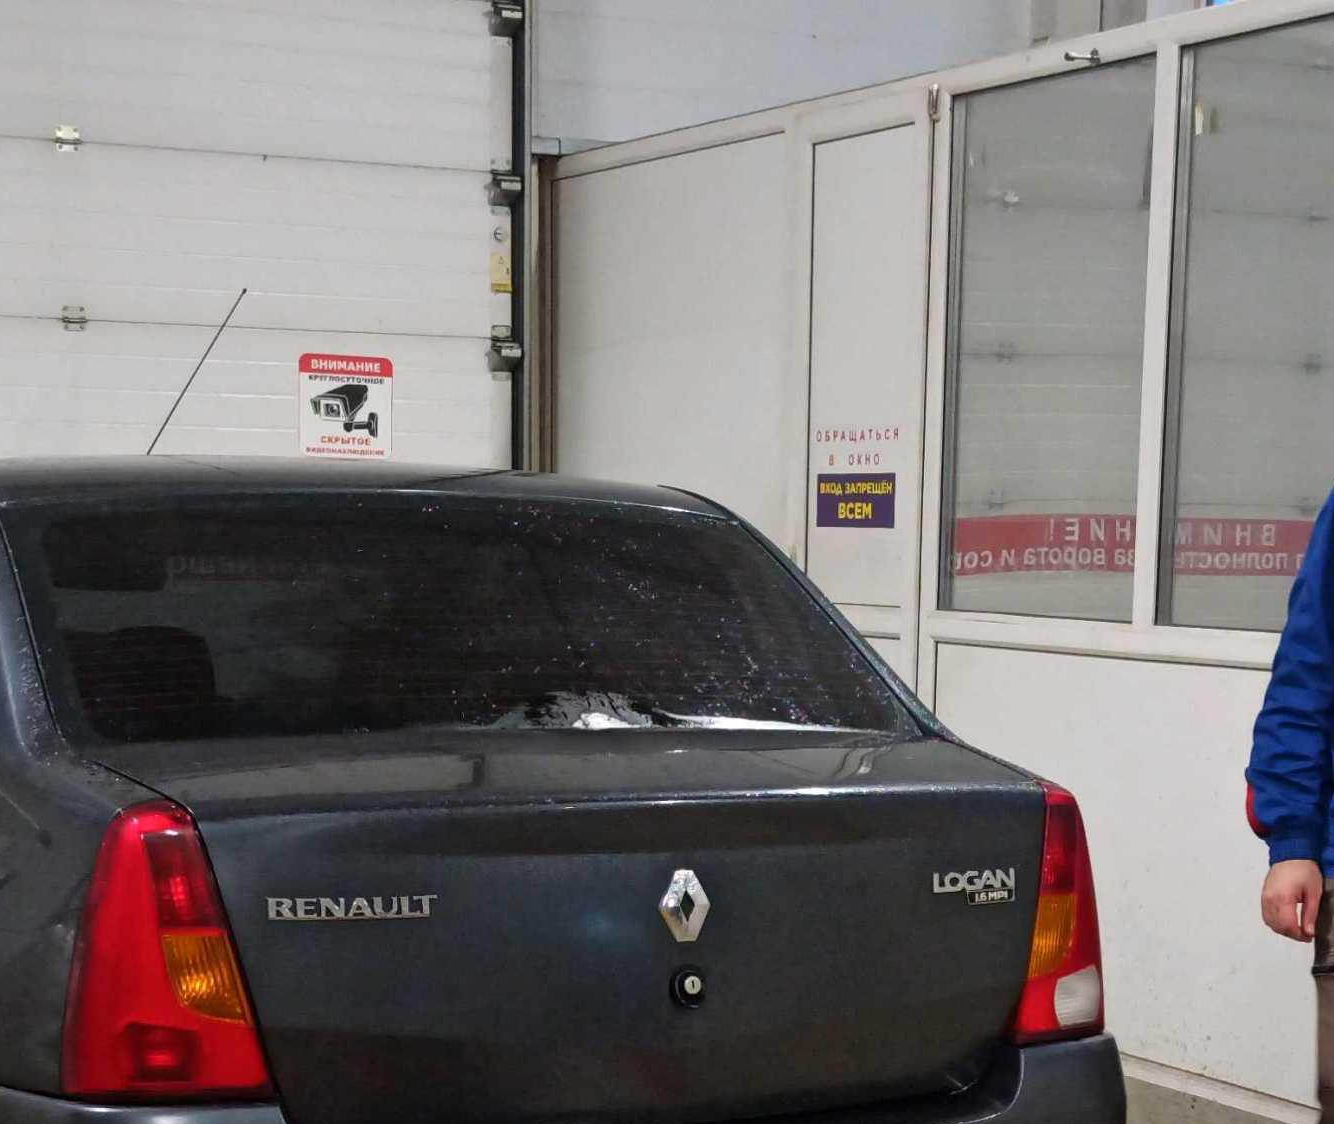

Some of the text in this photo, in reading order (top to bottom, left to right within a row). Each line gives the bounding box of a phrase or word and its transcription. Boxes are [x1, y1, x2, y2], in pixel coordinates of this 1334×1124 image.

[310, 358, 381, 373] ВНИМАНИЕ
[320, 436, 372, 446] СКРЫТОЕ
[816, 428, 899, 442] ОБРАЩАТЬСЯ
[829, 453, 880, 466] В ОКНО
[820, 482, 843, 496] ВХОД
[838, 502, 873, 520] ВСЕМ
[932, 867, 1015, 894] LOGAN
[266, 894, 438, 920] RENAULT
